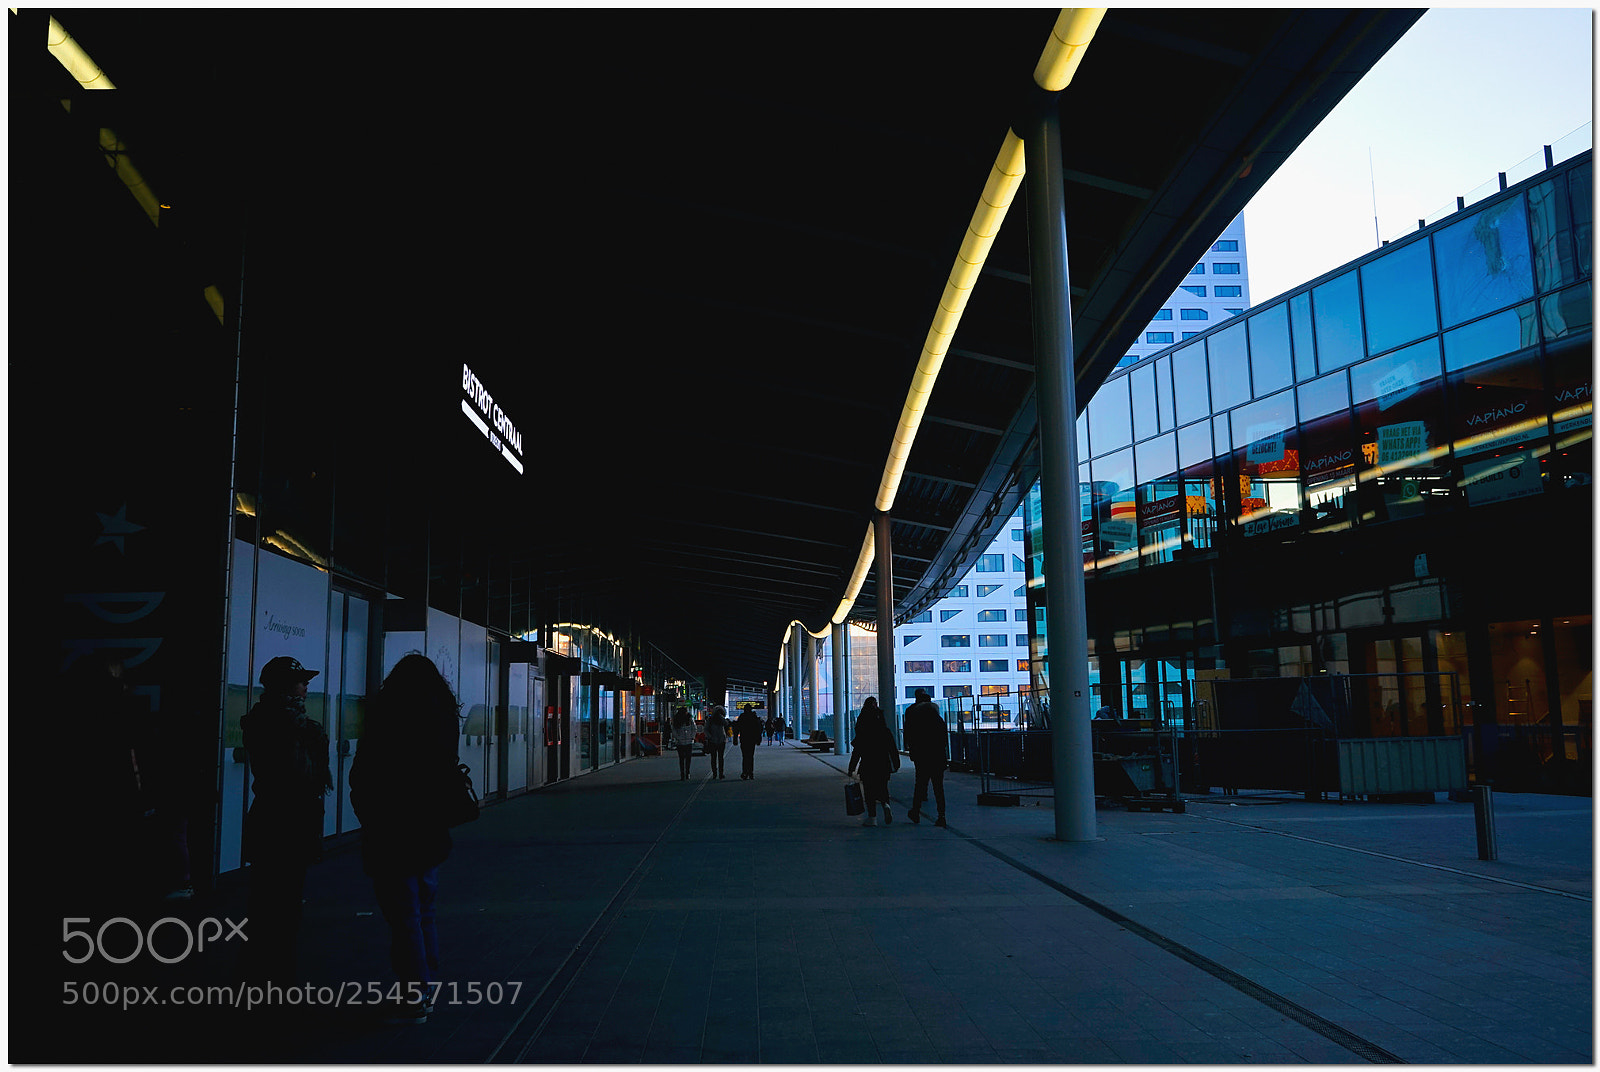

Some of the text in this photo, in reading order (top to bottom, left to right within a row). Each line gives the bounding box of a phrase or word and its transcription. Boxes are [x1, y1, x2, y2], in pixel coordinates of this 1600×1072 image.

[462, 362, 523, 457] BISTROT CENTRAAL
[1466, 402, 1526, 426] VAPIANO
[1382, 437, 1421, 451] WHATS APP!
[1304, 451, 1352, 471] VAPIANO
[1141, 500, 1175, 516] VAPIANO
